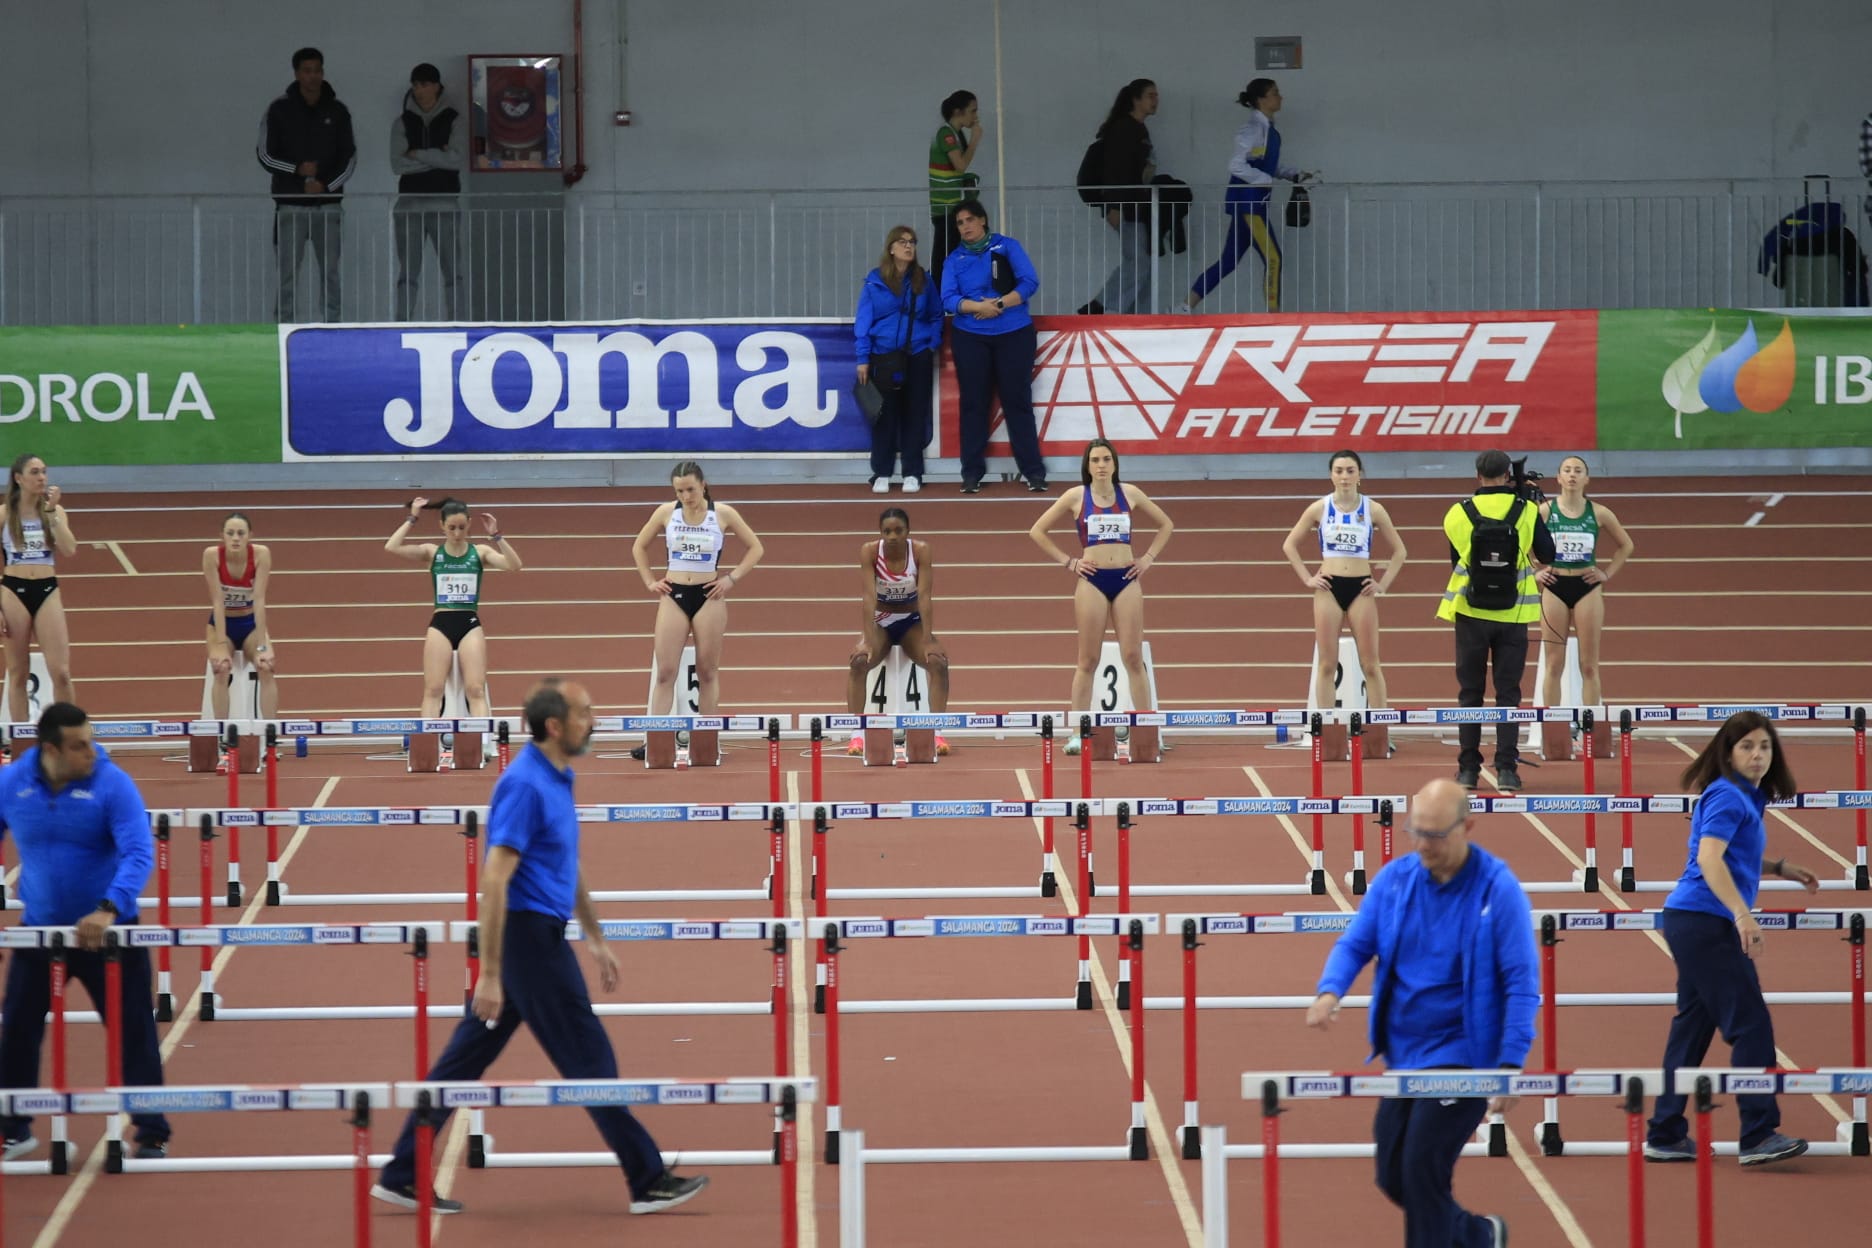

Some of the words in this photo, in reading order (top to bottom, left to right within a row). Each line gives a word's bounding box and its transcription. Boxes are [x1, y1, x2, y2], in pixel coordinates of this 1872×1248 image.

[1194, 322, 1556, 402] RFEA
[1815, 355, 1872, 405] IB
[0, 372, 216, 424] DROLA
[1176, 404, 1521, 438] ATLETISMO
[1098, 524, 1120, 533] 373
[1335, 533, 1357, 545] 428
[681, 543, 701, 552] 381
[1562, 542, 1584, 553] 322
[447, 583, 468, 594] 310
[870, 665, 887, 713] 4
[906, 663, 921, 711] 4
[1101, 664, 1118, 712] 3
[1214, 714, 1231, 723] 2024
[1485, 710, 1501, 719] 2024
[670, 719, 688, 728] 2024
[944, 716, 960, 726] 2024
[400, 723, 416, 731] 2024
[967, 804, 985, 814] 2024
[1273, 801, 1291, 811] 2024
[1582, 799, 1600, 810] 2024
[354, 812, 374, 822] 2024
[663, 806, 682, 818] 2024
[997, 920, 1019, 932] 2024
[1755, 916, 1785, 925] oma
[603, 924, 642, 937] AMANCA
[643, 924, 666, 936] 2024
[1476, 1079, 1499, 1092] 2024
[625, 1087, 650, 1100] 2024
